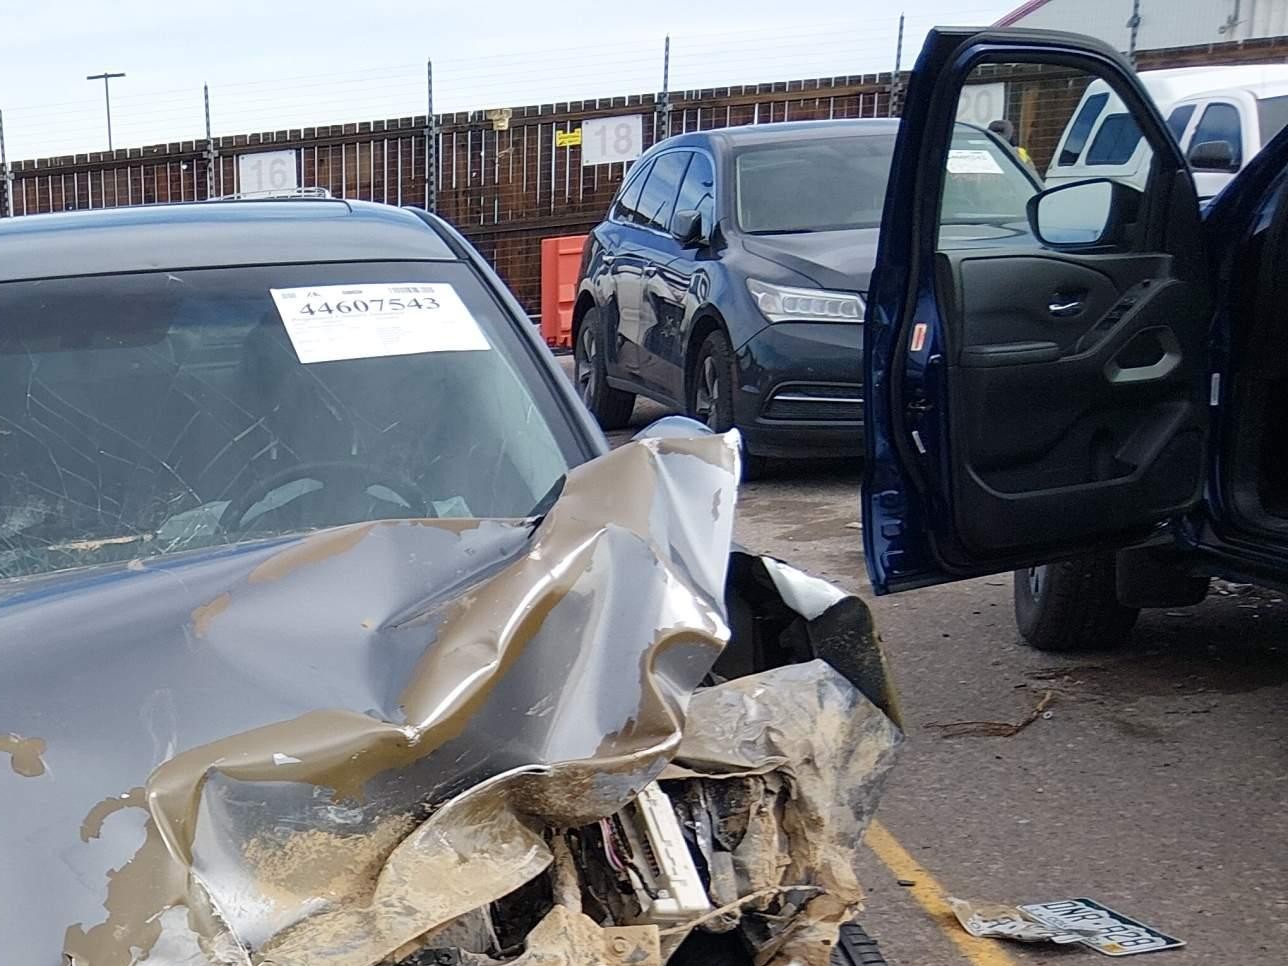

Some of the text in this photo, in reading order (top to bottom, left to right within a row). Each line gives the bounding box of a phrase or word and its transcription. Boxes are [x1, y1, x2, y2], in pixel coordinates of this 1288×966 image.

[594, 122, 632, 157] 18
[250, 158, 289, 190] 16
[300, 296, 441, 316] 44607543
